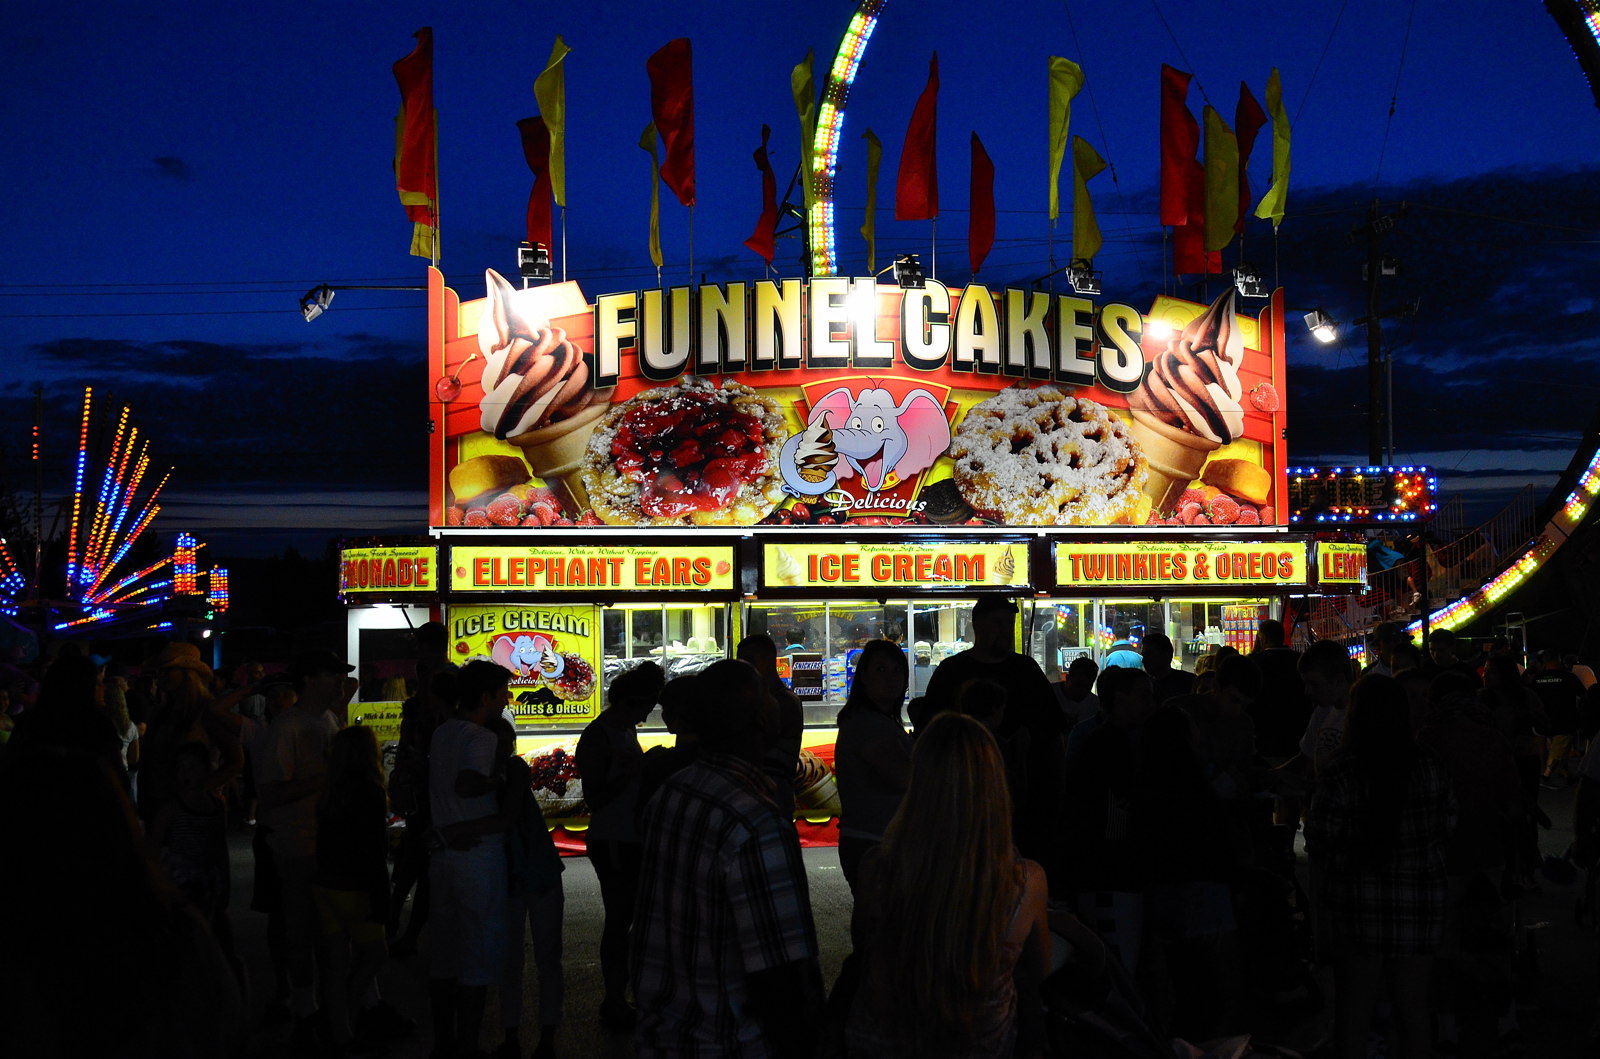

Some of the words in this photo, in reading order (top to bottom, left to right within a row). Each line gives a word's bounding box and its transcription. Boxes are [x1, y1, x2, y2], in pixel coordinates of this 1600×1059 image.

[594, 277, 895, 389] FUNNEL
[900, 279, 1146, 393] CAKES
[823, 488, 928, 513] Delicious
[597, 547, 624, 555] Without
[627, 547, 658, 556] Toppings
[1178, 544, 1201, 552] Deep
[1204, 543, 1227, 551] Fried
[343, 557, 429, 588] MONADE
[473, 557, 624, 586] ELEPHANT
[635, 557, 712, 586] EARS
[807, 554, 860, 582] ICE
[871, 554, 985, 582] CREAM
[1069, 552, 1187, 580] TWINKIES
[1192, 552, 1210, 580] &
[1215, 552, 1294, 579] OREOS
[456, 612, 496, 638] ICE
[504, 610, 591, 637] CREAM
[793, 661, 823, 671] SNICKERS
[793, 687, 823, 696] SNICKERS
[546, 703, 554, 715] &
[556, 703, 590, 715] OREOS
